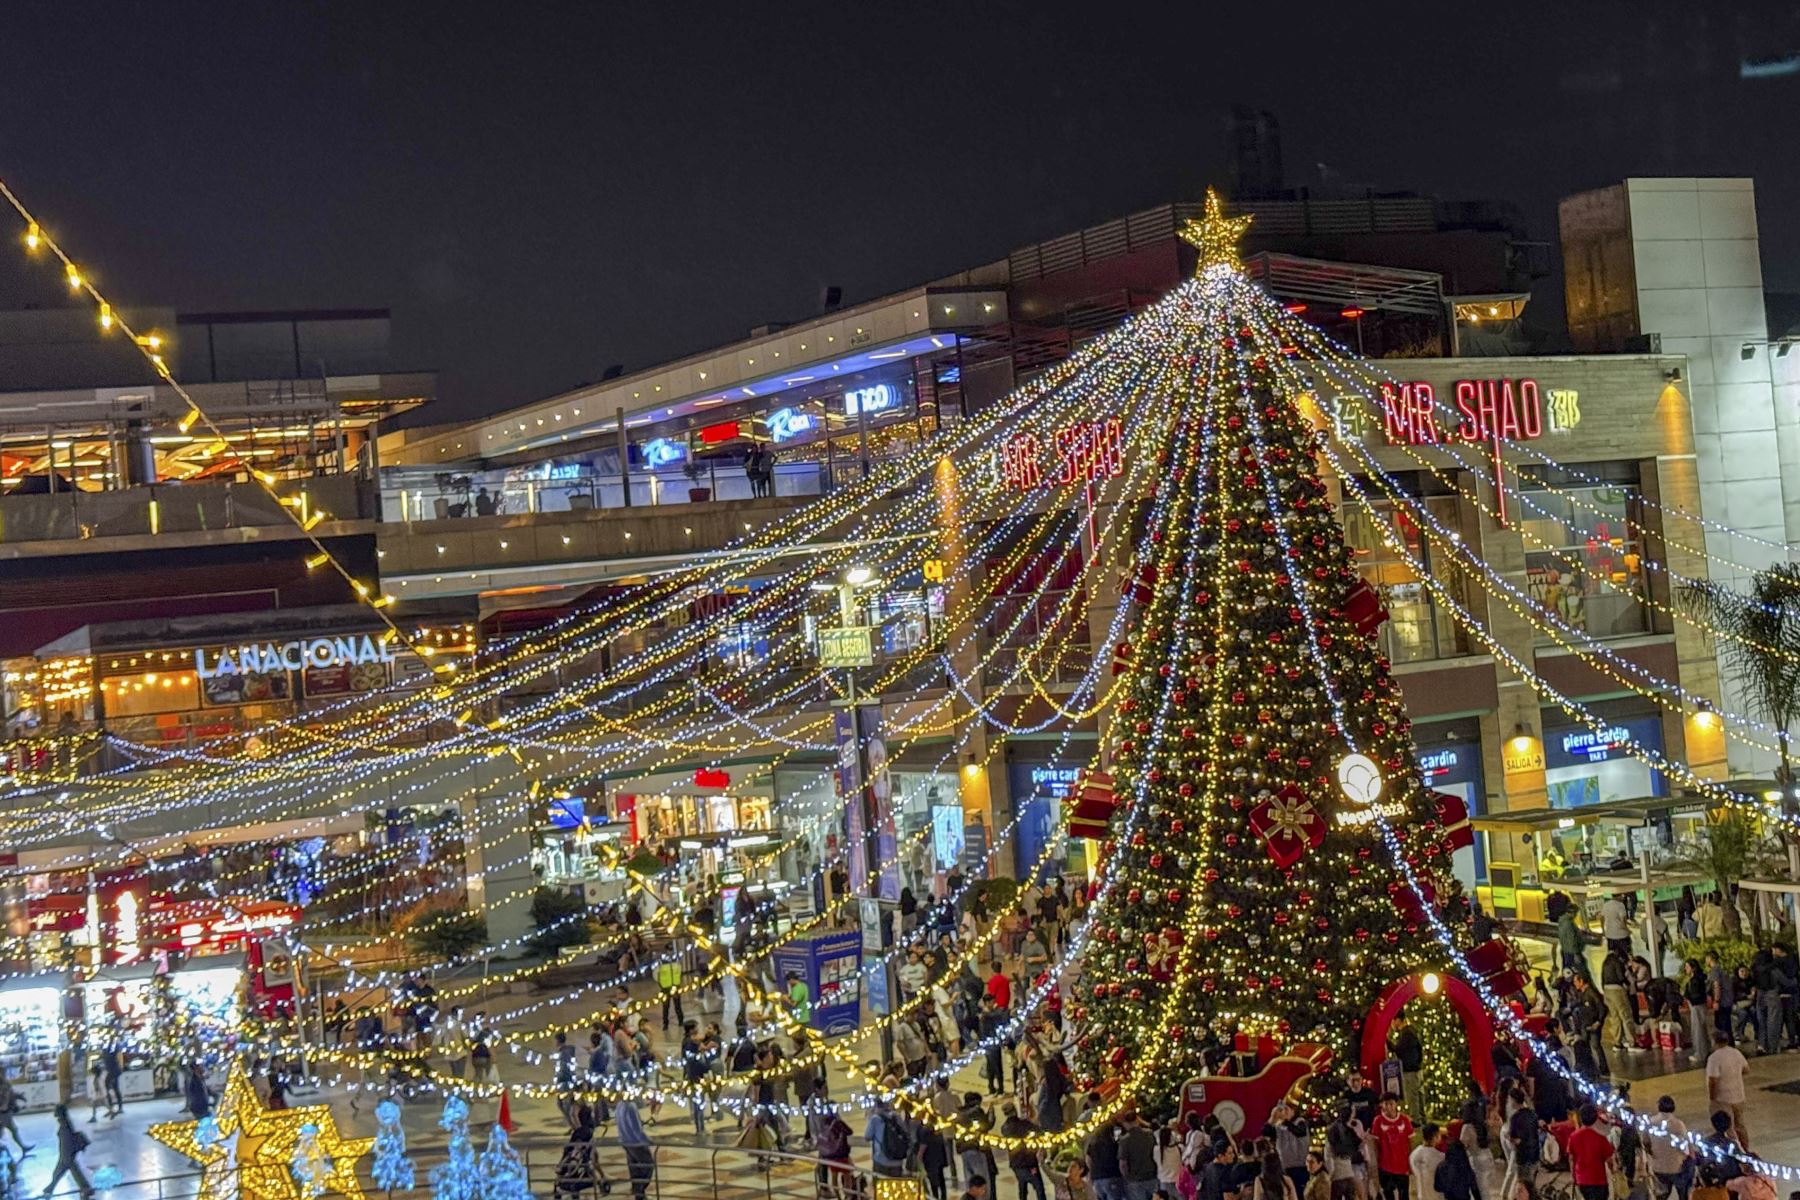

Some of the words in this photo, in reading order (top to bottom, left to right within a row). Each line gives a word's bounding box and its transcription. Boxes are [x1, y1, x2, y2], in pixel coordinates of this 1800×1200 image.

[1455, 377, 1543, 443] SHAO
[1055, 415, 1124, 485] SHAO
[1420, 750, 1457, 768] cardin
[1563, 732, 1595, 751] pierre
